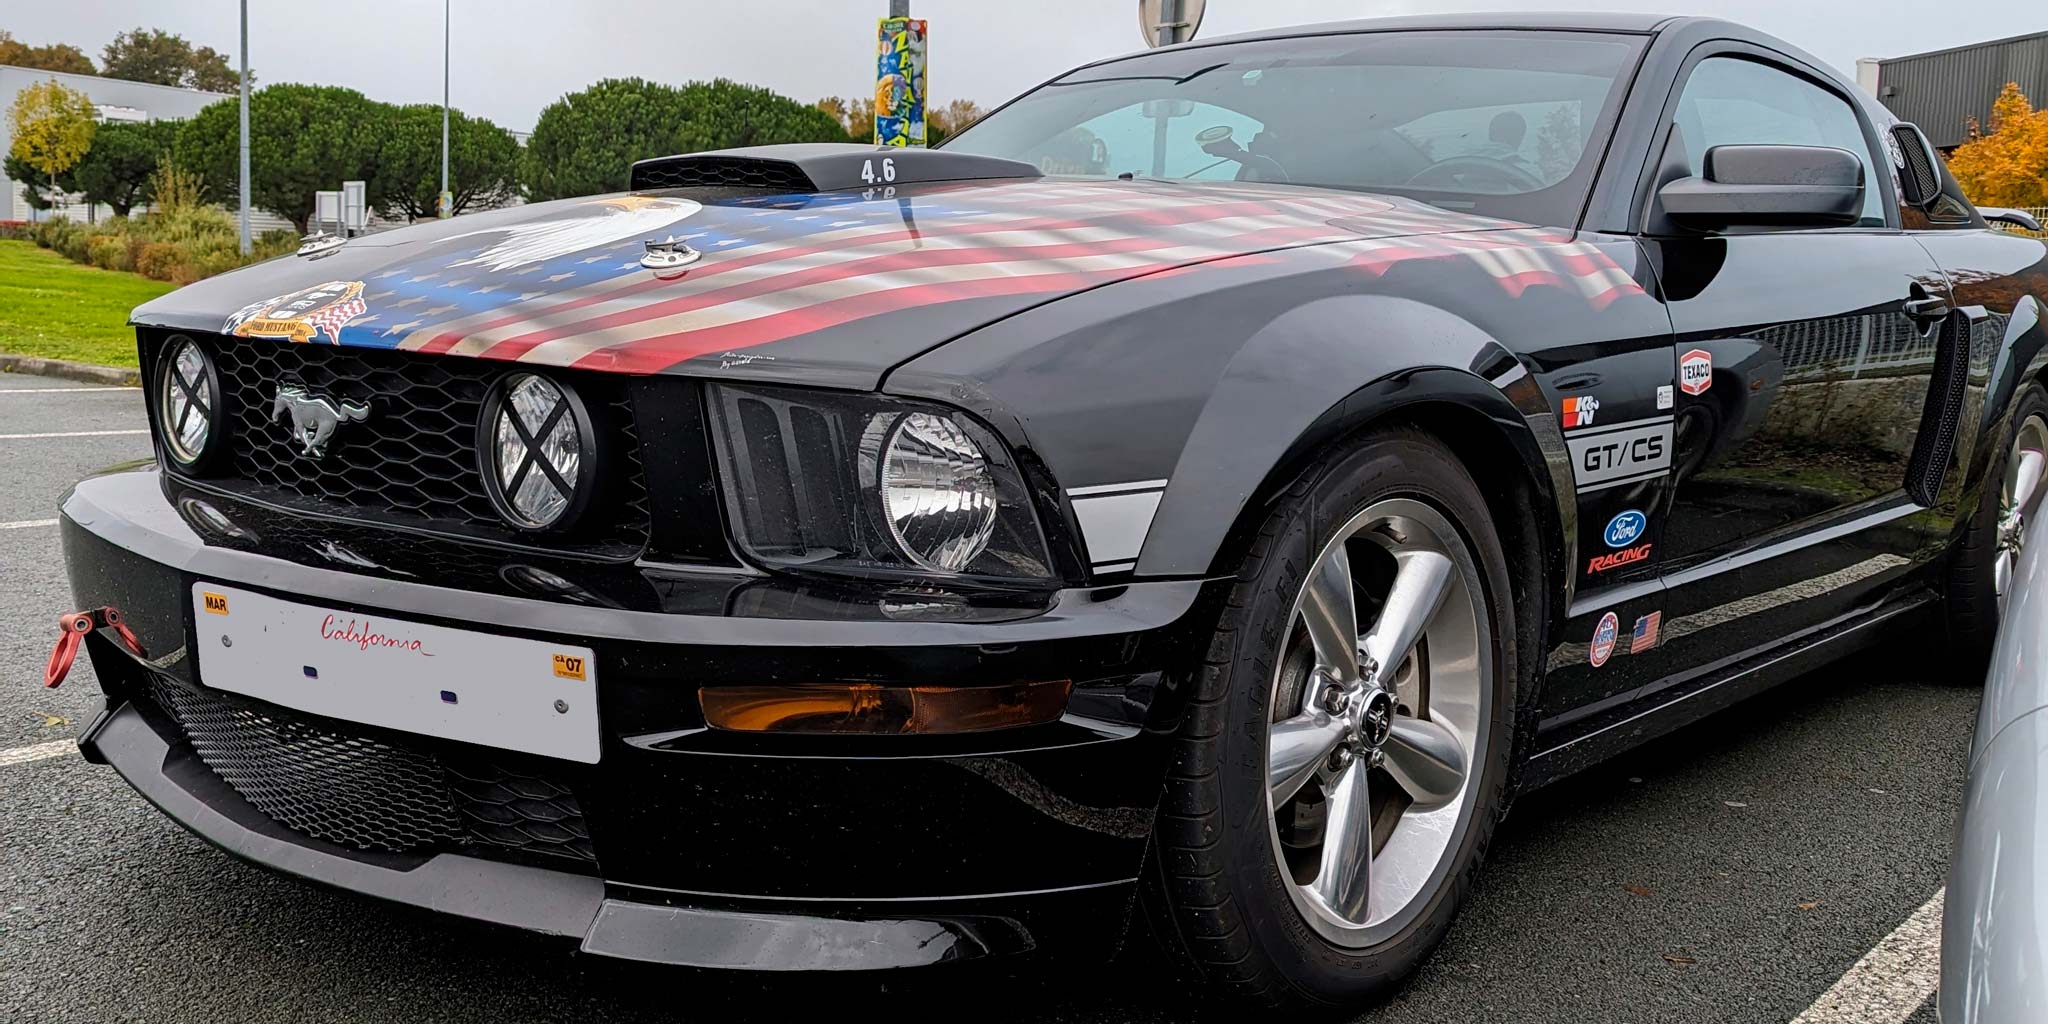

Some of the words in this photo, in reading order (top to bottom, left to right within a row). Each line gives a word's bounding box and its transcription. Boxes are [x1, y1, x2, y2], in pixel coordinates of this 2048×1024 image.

[861, 158, 896, 184] 4.6
[250, 320, 266, 332] FORD
[264, 320, 299, 333] MUSTANG
[1683, 362, 1710, 380] TEXACO
[1584, 435, 1663, 472] GT/CS
[1611, 516, 1639, 541] Ford
[1587, 543, 1653, 575] RACING
[205, 596, 227, 612] MAR
[321, 614, 437, 657] California
[554, 655, 566, 663] CA
[565, 657, 582, 672] 07
